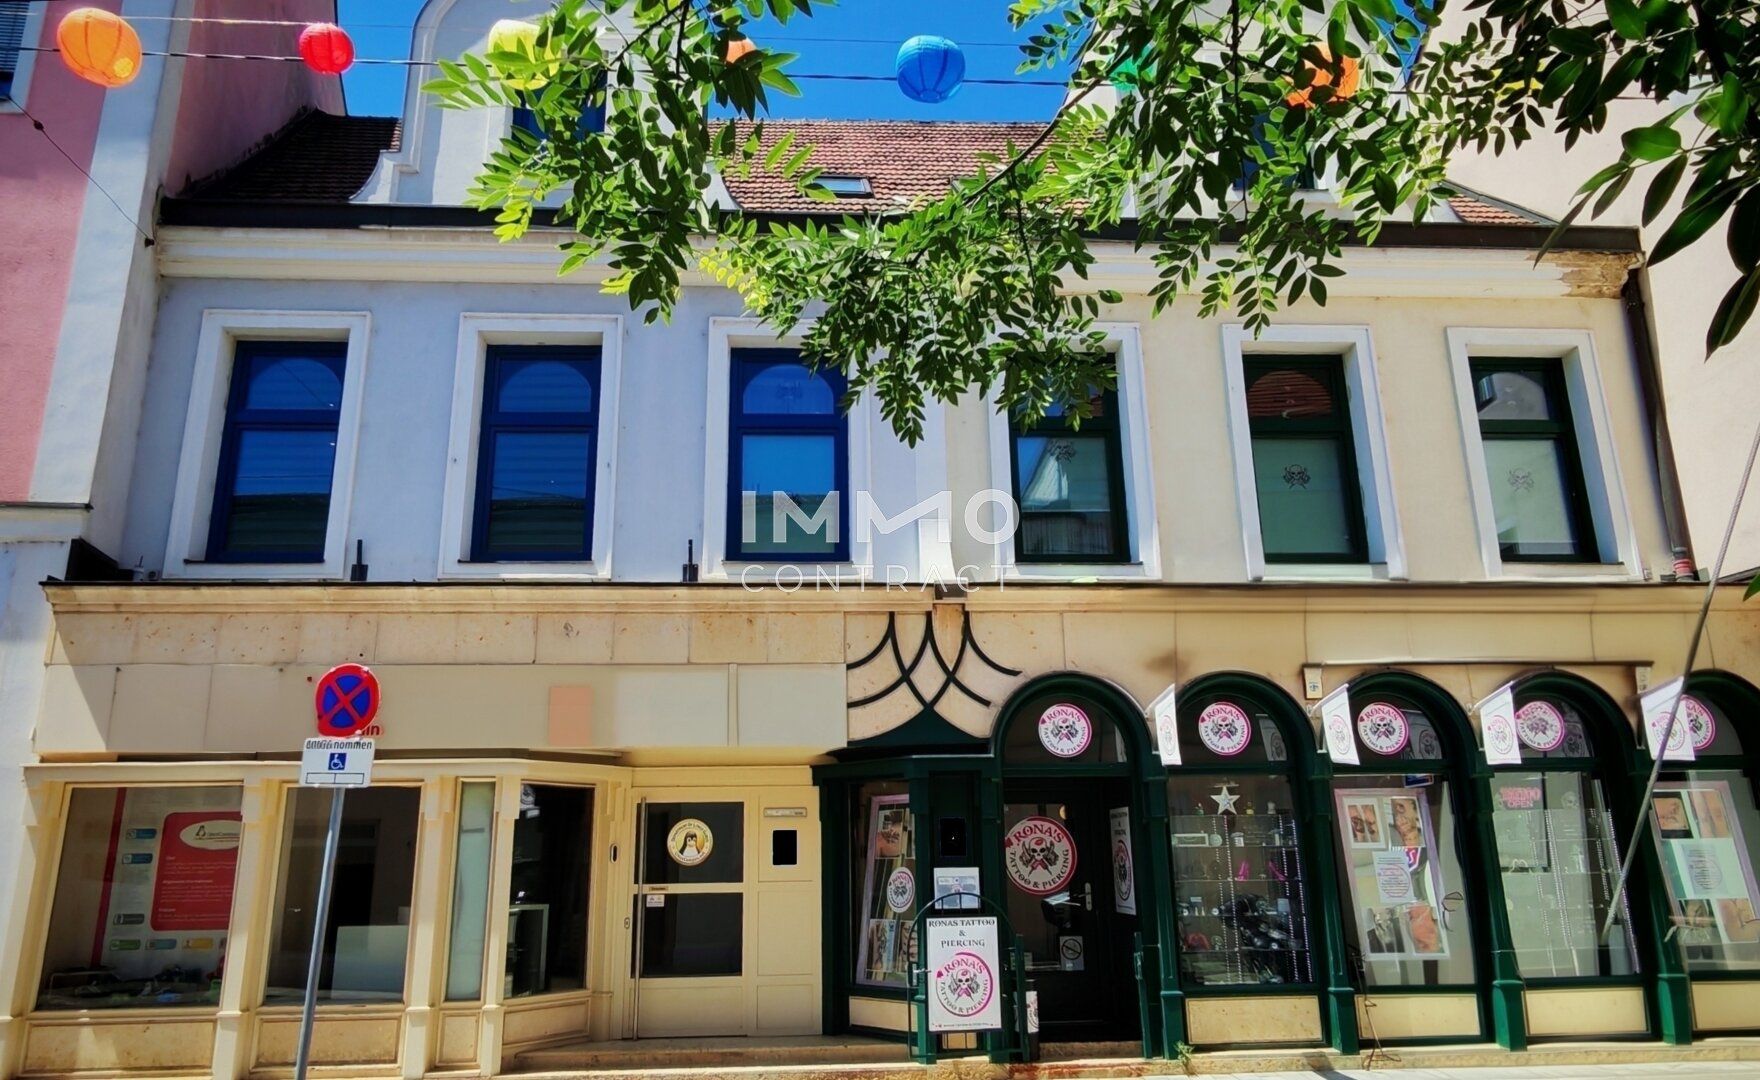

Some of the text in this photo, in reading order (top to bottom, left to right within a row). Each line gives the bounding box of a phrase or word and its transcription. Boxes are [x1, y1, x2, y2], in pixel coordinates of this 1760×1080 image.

[1013, 824, 1064, 845] RONA'S
[1009, 849, 1070, 890] TATTOO & PIERCING
[928, 919, 996, 928] RONAS TATTOO
[958, 929, 967, 937] &
[940, 939, 986, 949] PIERCING
[944, 958, 986, 976] RONA'S
[940, 981, 957, 1011] TATTOO
